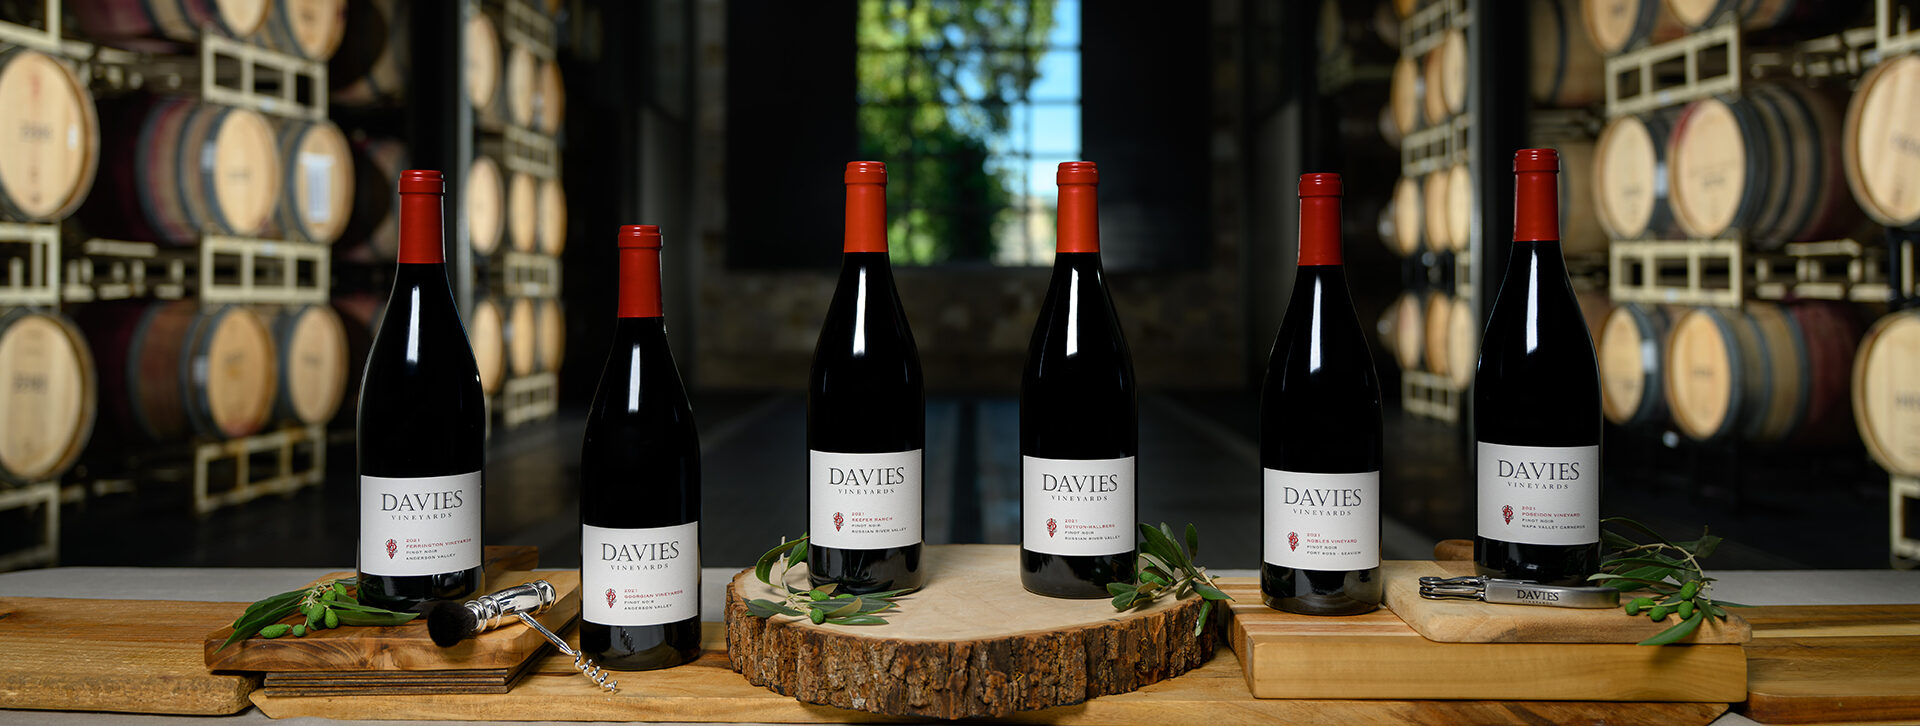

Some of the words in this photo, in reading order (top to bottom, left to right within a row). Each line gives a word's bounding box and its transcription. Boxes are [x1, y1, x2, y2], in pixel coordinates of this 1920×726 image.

[828, 466, 904, 486] DAVIES
[1497, 459, 1580, 480] DAVIES
[1042, 474, 1118, 493] DAVIES
[1508, 481, 1569, 490] VINEYARDS
[381, 490, 463, 511] DAVIES
[1283, 487, 1362, 507] DAVIES
[601, 541, 679, 561] DAVIES
[1517, 590, 1559, 601] DAVIES
